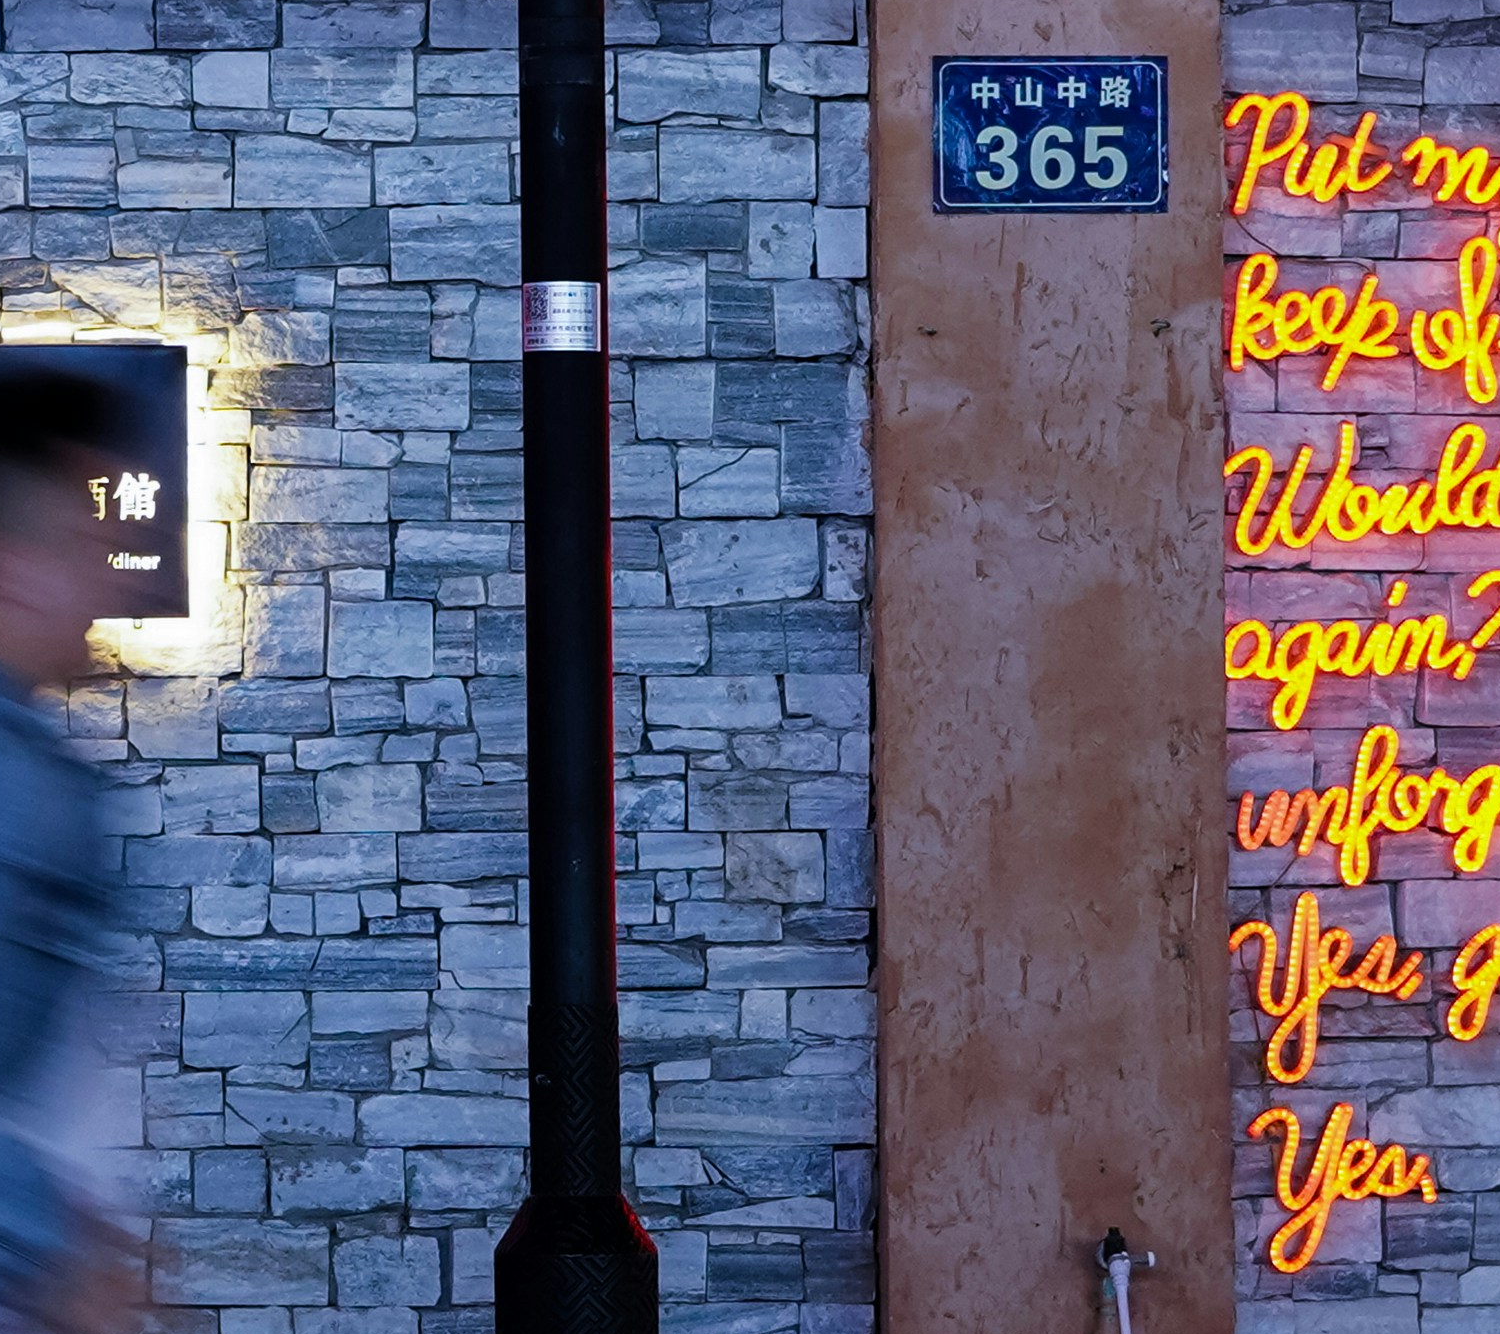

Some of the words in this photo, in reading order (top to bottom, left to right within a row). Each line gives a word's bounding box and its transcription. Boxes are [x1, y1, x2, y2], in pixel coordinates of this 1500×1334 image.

[970, 75, 1132, 109] 中山中路
[975, 125, 1129, 190] 365
[1225, 91, 1393, 215] Put
[1229, 253, 1400, 391] keep
[1411, 236, 1500, 404] of
